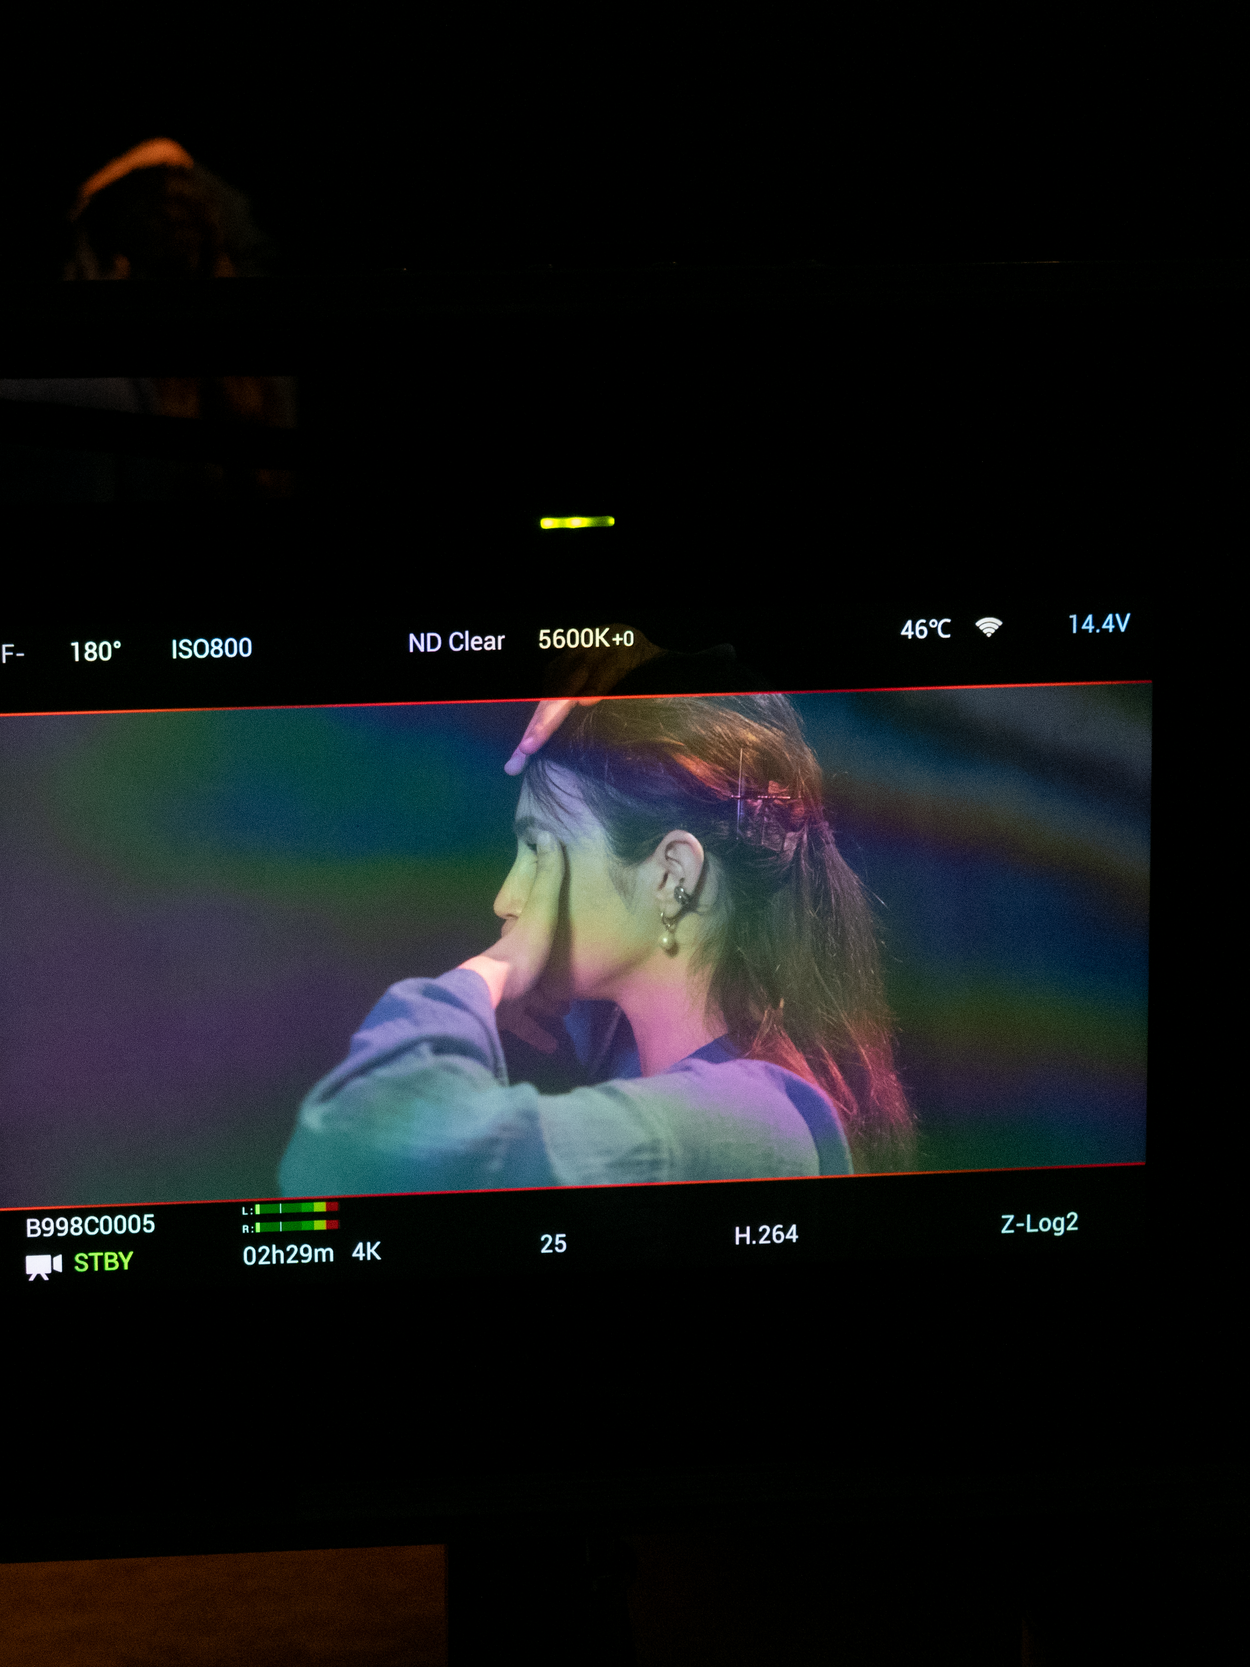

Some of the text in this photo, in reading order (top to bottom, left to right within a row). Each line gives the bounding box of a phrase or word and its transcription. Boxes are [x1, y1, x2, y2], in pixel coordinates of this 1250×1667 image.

[1068, 612, 1132, 634] 14.4V
[71, 640, 122, 662] 180°
[171, 637, 253, 660] ISO800
[409, 629, 506, 653] ND Clear
[25, 1213, 156, 1238] B998C0005
[734, 1223, 799, 1246] H.264
[1000, 1211, 1079, 1237] Z-Log2
[242, 1243, 334, 1266] 02h29m
[351, 1240, 382, 1261] 4K
[540, 1233, 567, 1254] 25
[73, 1250, 134, 1273] STBY
